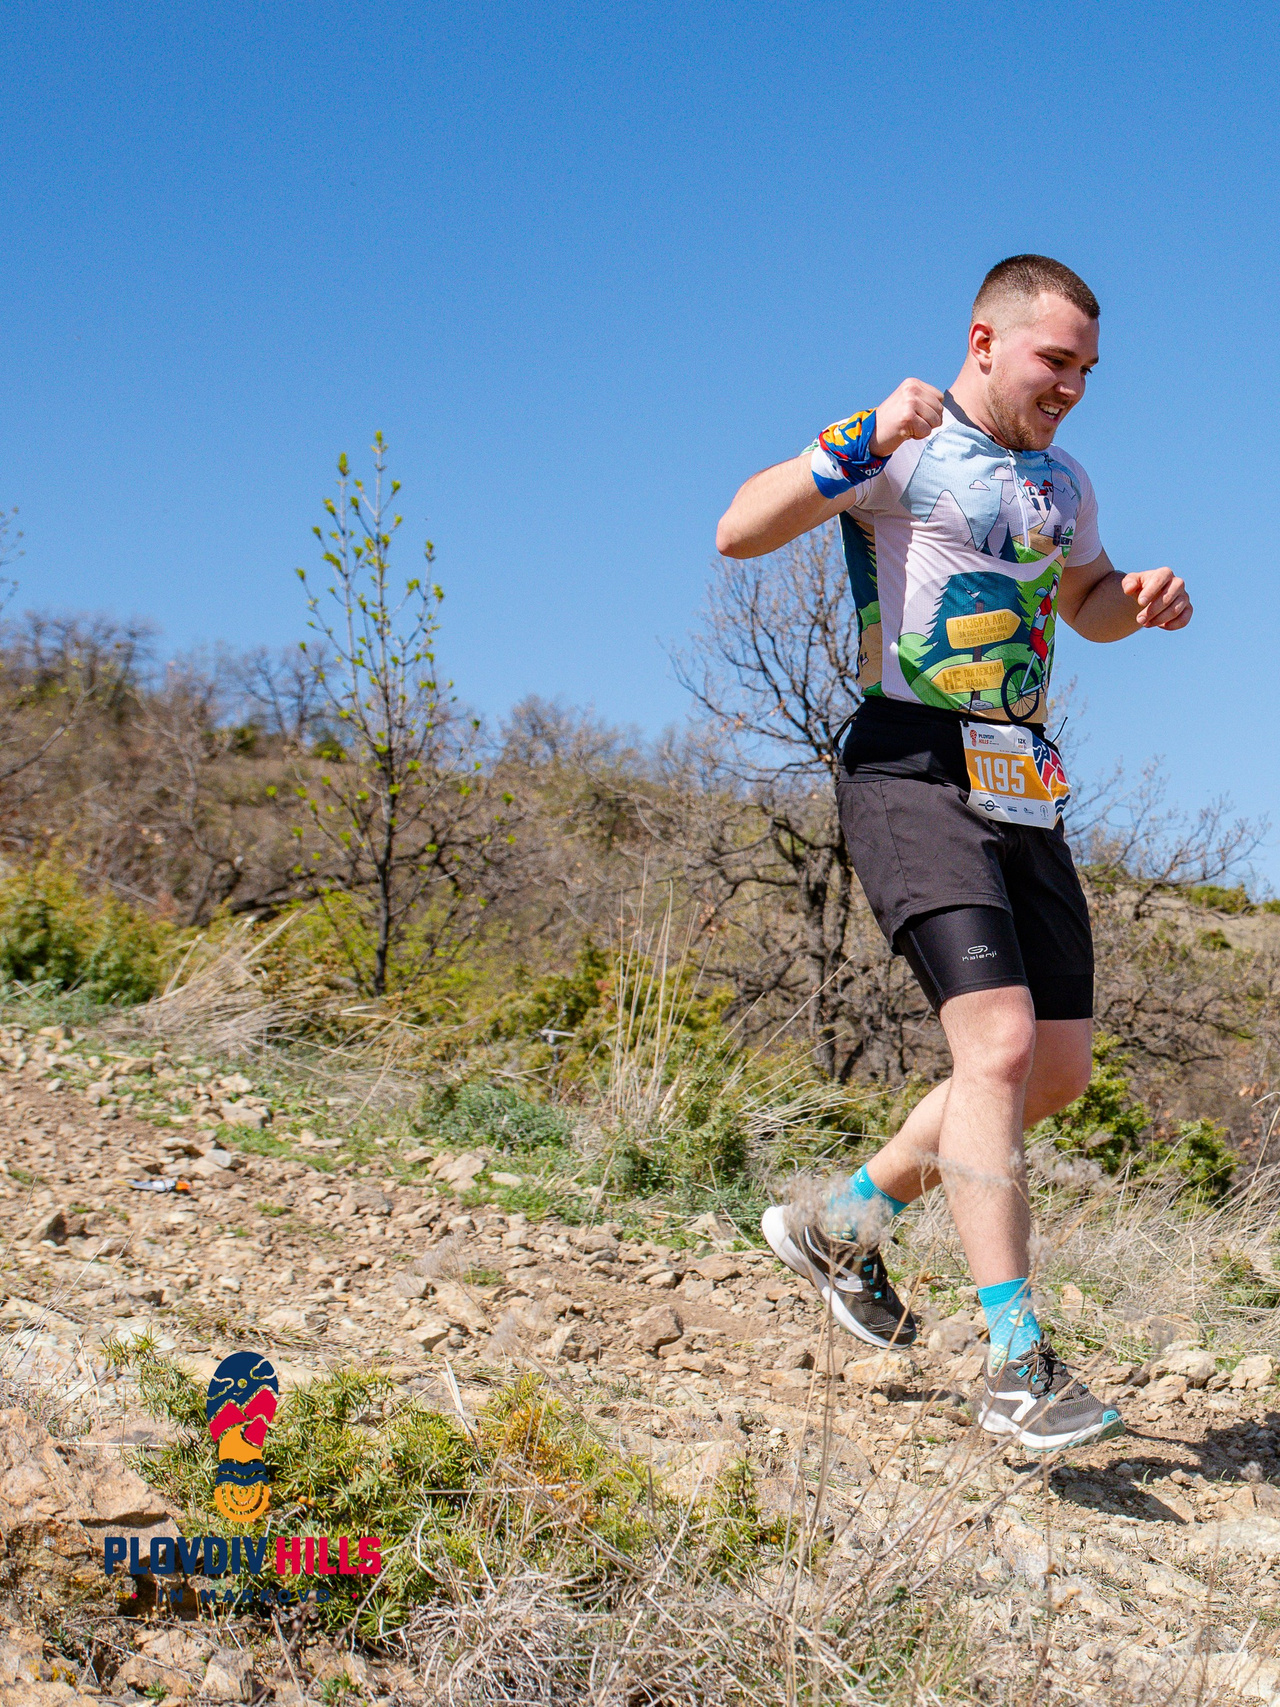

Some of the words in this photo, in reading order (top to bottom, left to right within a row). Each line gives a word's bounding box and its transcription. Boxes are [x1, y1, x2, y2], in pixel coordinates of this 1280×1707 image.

[956, 616, 990, 630] РАЗБРА
[964, 663, 1002, 677] ПОГЛЕЖДАЙ
[942, 670, 964, 690] НЕ
[966, 678, 988, 688] НАЗАД
[974, 756, 1025, 794] 1195
